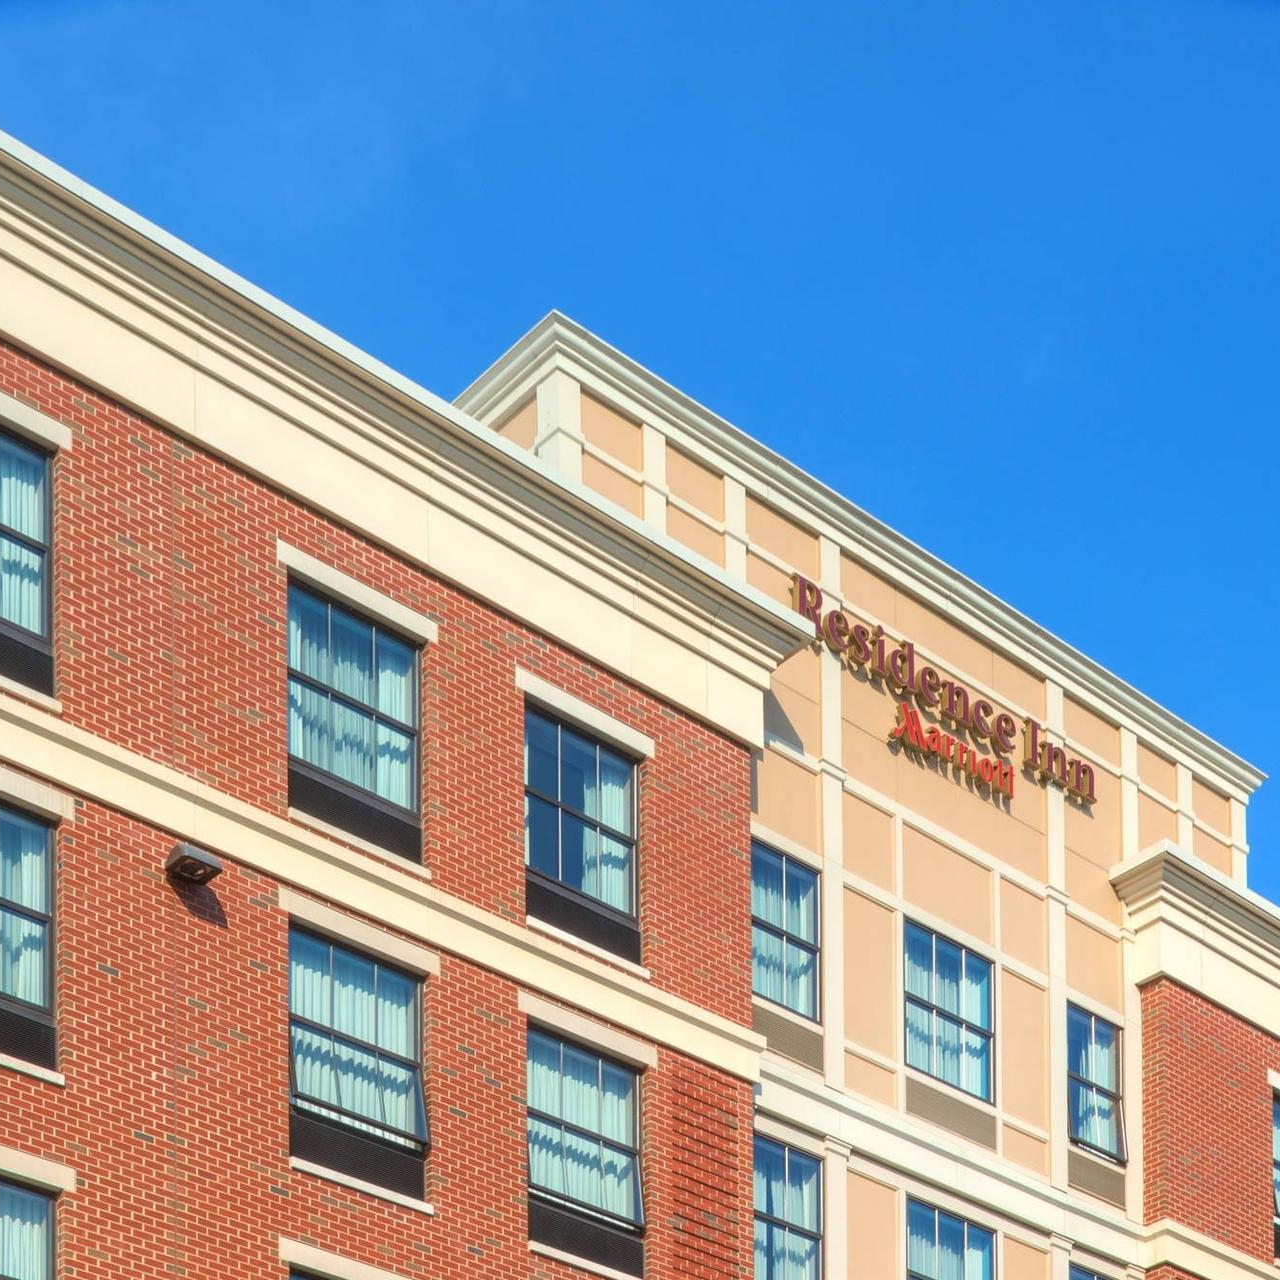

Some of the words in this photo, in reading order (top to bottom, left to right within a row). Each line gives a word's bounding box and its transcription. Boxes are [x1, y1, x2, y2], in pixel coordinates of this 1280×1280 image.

[790, 572, 1017, 754] Residence
[1023, 716, 1097, 805] Inn
[888, 703, 1014, 800] Marriott
